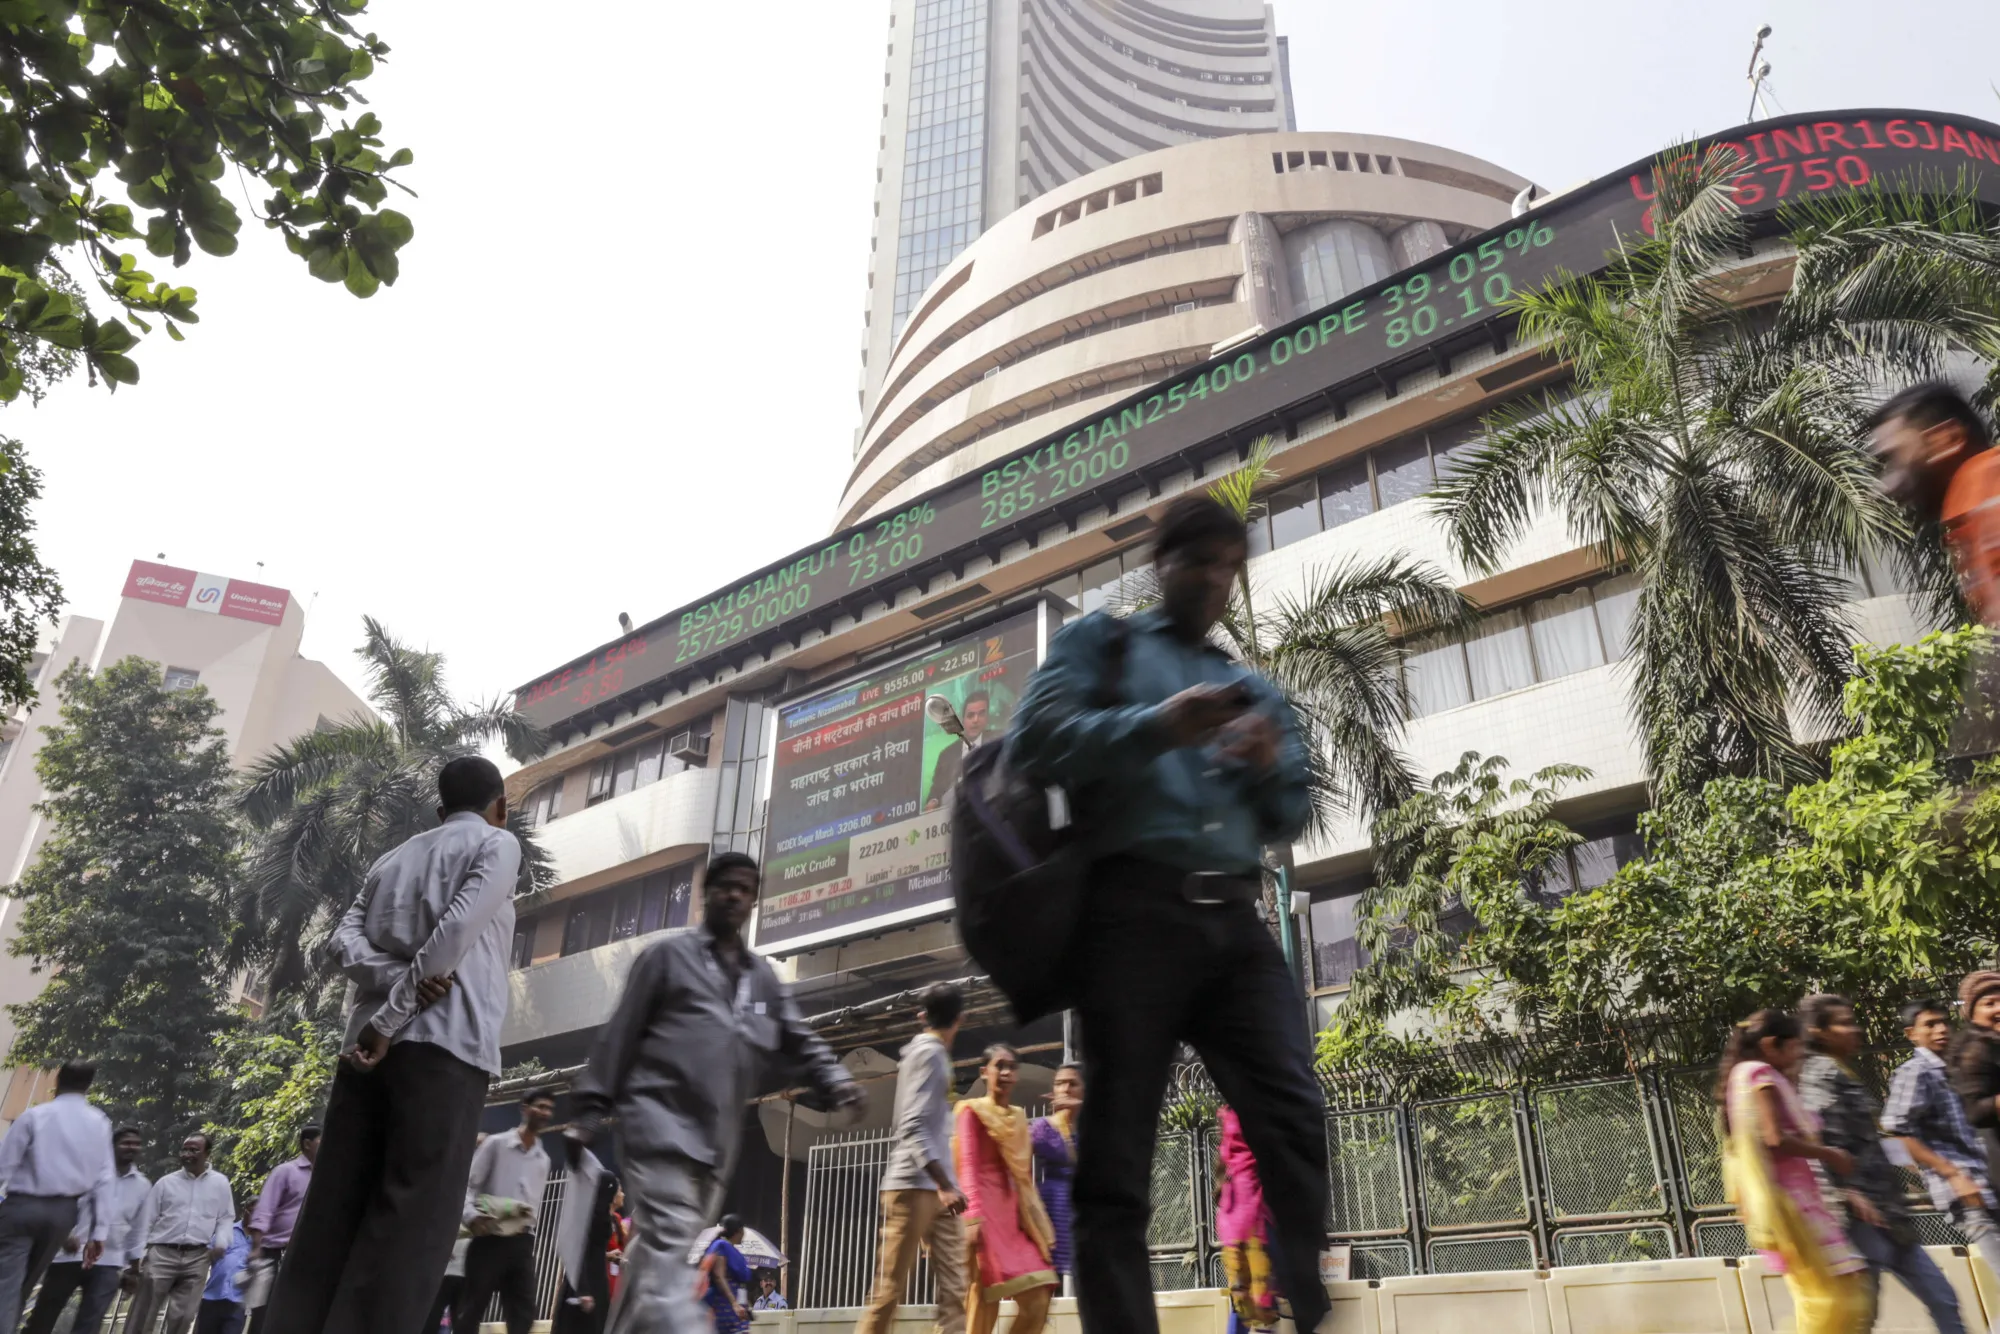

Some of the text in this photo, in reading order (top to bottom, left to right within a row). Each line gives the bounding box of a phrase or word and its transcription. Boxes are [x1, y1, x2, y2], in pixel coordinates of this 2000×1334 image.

[1629, 119, 2000, 201] UDINR16JAN
[981, 219, 1556, 498] BSX16JAN25400.00PE 39.05%
[980, 272, 1512, 528] 285.2000 80.10
[679, 500, 935, 637] BSX16JANFUT 0.28%
[230, 592, 282, 609] Union Bank
[675, 533, 922, 663] 25729.0000 73.00
[862, 687, 880, 702] LIVE
[884, 669, 924, 694] 9555.00
[941, 650, 975, 672] -22.50
[865, 713, 877, 729] की
[900, 696, 921, 717] होगी
[833, 753, 870, 776] सरकार
[872, 746, 881, 762] ने
[884, 740, 910, 759] दिया
[806, 771, 884, 807] जांच का भरोसा
[776, 840, 796, 854] NCDEX
[814, 826, 834, 841] March
[837, 814, 872, 835] 3206.00
[887, 801, 916, 818] -10.00
[859, 836, 899, 860] 2272.00
[784, 856, 836, 880] MCX Crude
